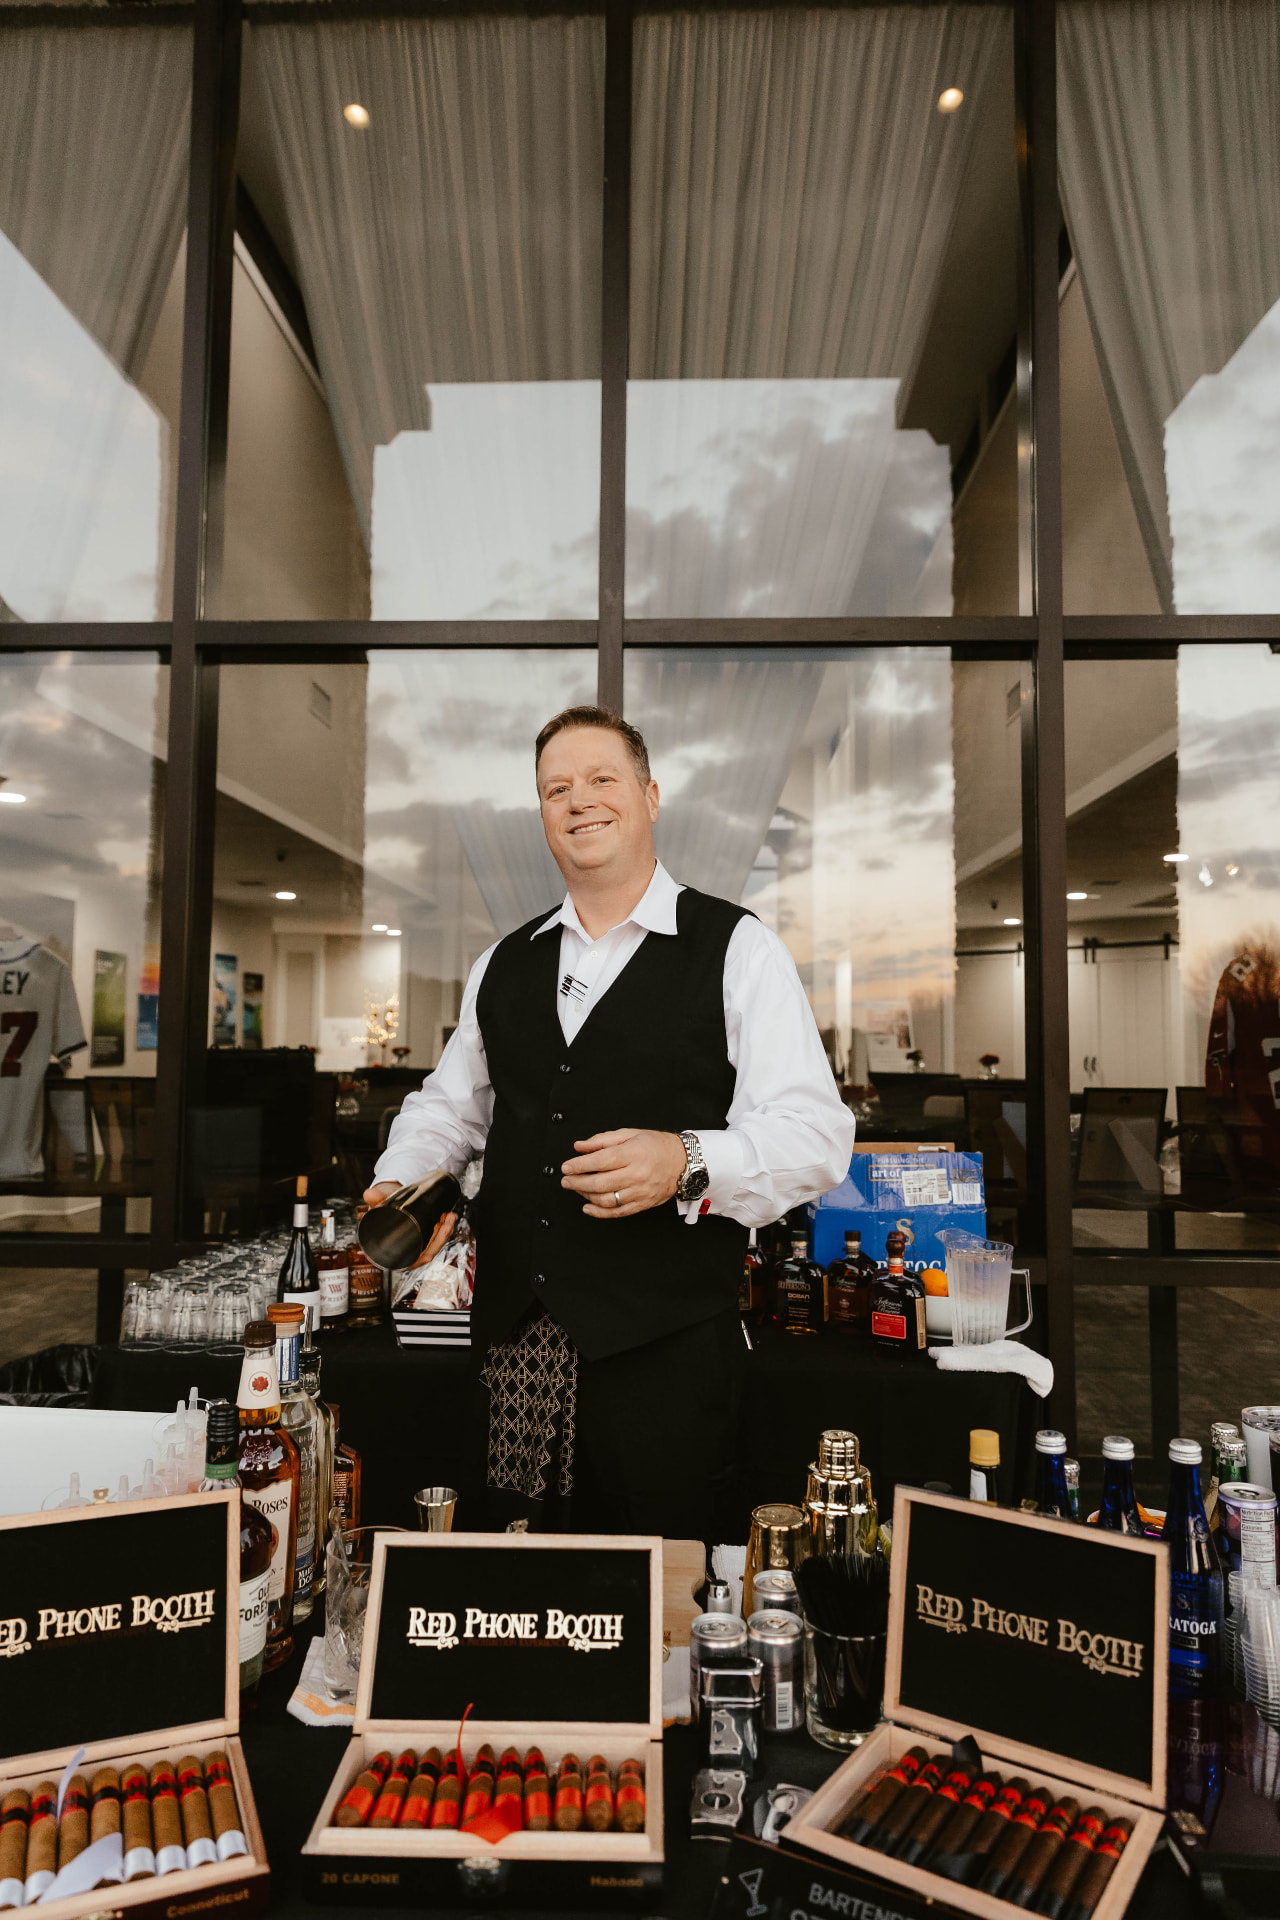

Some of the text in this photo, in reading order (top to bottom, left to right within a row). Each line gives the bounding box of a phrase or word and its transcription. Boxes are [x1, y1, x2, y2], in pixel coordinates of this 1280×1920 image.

[0, 971, 30, 995] EY
[2, 1012, 39, 1078] 7
[871, 1167, 901, 1178] art of
[252, 1497, 288, 1515] Roses
[0, 1618, 28, 1647] ED
[36, 1603, 122, 1641] PHONE
[130, 1588, 216, 1627] BOOTH
[406, 1607, 624, 1640] RED PHONE BOOTH
[916, 1584, 964, 1623] RED
[971, 1598, 1049, 1646] PHONE
[1057, 1618, 1144, 1671] BOOTH
[321, 1872, 400, 1885] 20 CAPONE
